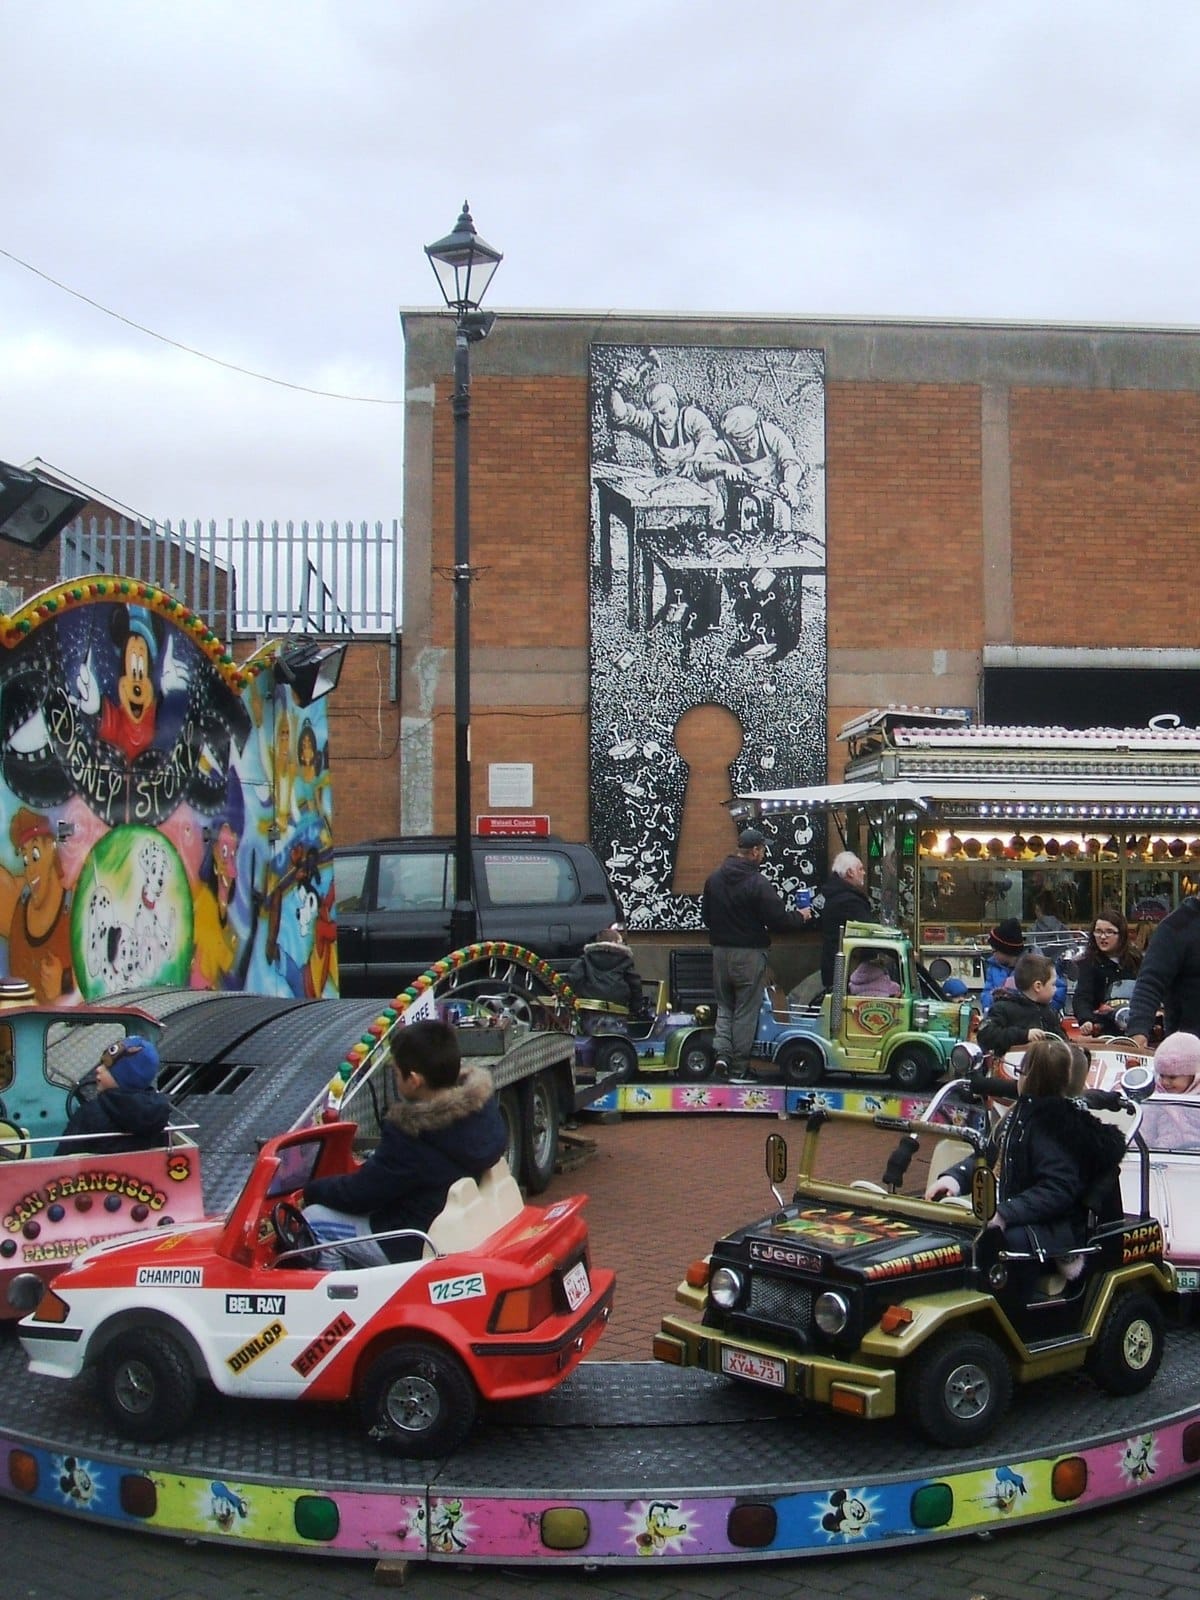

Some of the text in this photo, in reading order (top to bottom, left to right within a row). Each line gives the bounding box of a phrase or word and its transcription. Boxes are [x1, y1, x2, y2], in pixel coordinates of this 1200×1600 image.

[135, 720, 194, 818] STORY
[167, 1155, 190, 1182] 3
[3, 1170, 168, 1233] SAN FRANCISCO
[22, 1238, 88, 1262] PACIFIC
[138, 1269, 201, 1285] CHAMPION
[432, 1277, 482, 1300] NSR
[229, 1296, 283, 1314] BEL RAY
[227, 1323, 282, 1372] DUNLOP
[298, 1318, 351, 1374] ERTOIL
[730, 1358, 781, 1382] XY 731
